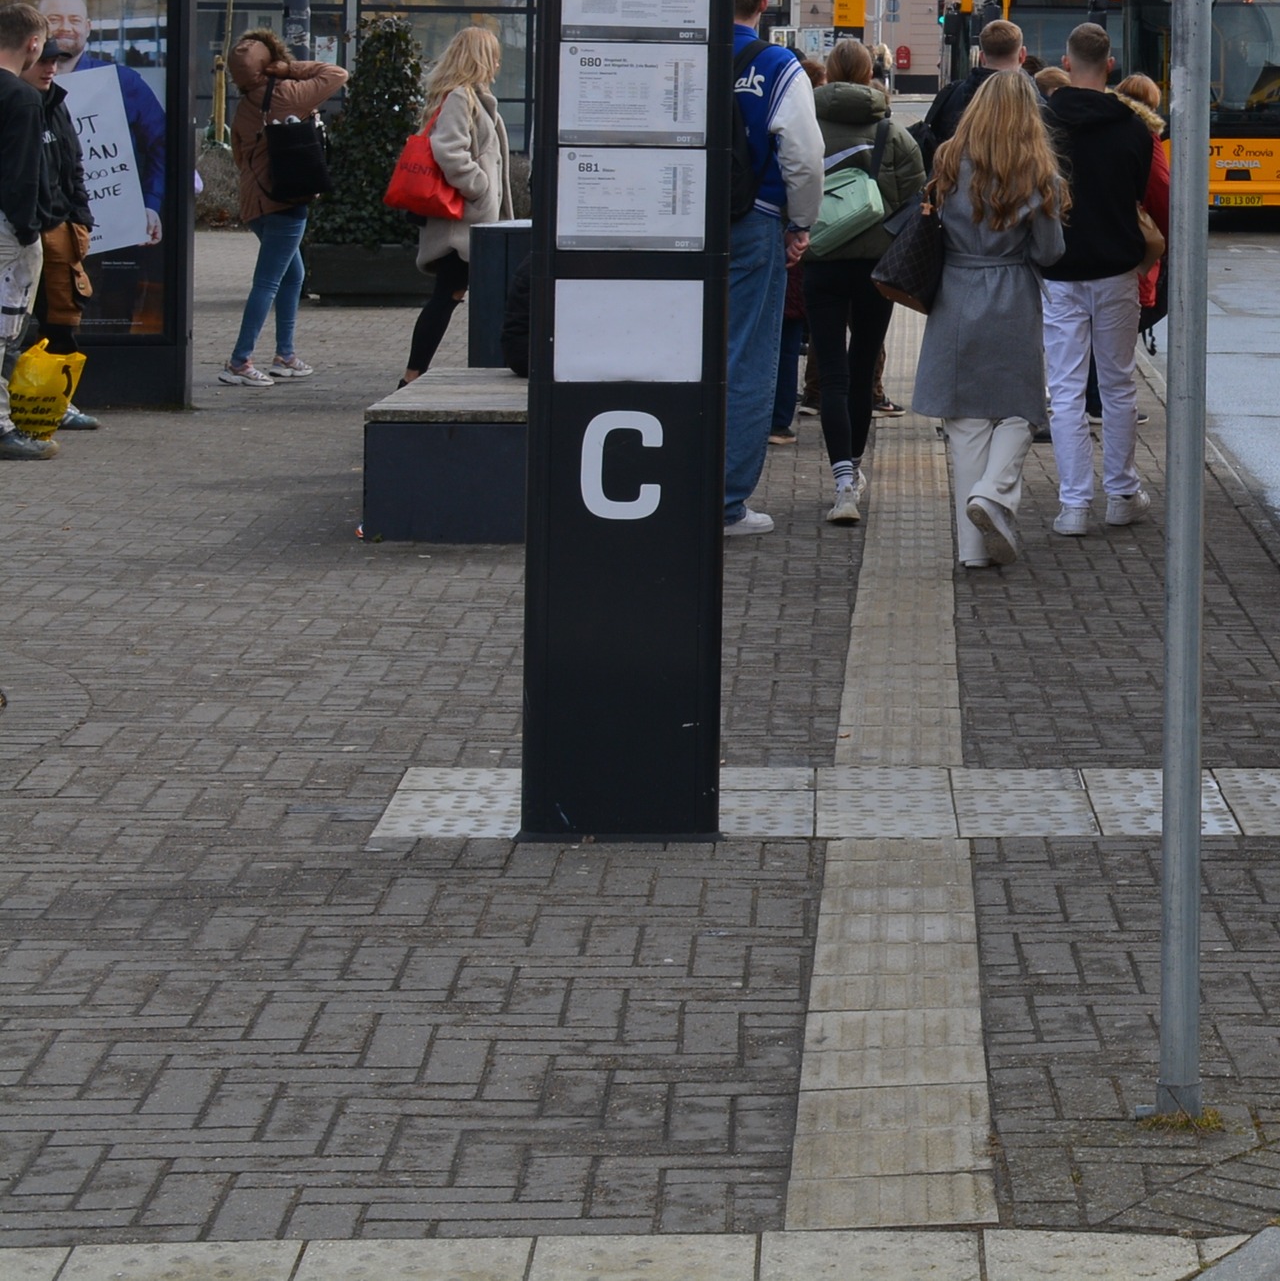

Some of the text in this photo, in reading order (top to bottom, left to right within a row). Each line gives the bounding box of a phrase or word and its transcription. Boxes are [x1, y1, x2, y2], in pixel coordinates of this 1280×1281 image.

[580, 57, 602, 67] 680
[1245, 148, 1273, 157] movia
[578, 163, 599, 172] 681
[1216, 160, 1261, 168] SCANIA
[86, 183, 122, 201] ENTE
[1234, 196, 1244, 204] 13
[1245, 196, 1261, 205] 007
[580, 410, 663, 520] C
